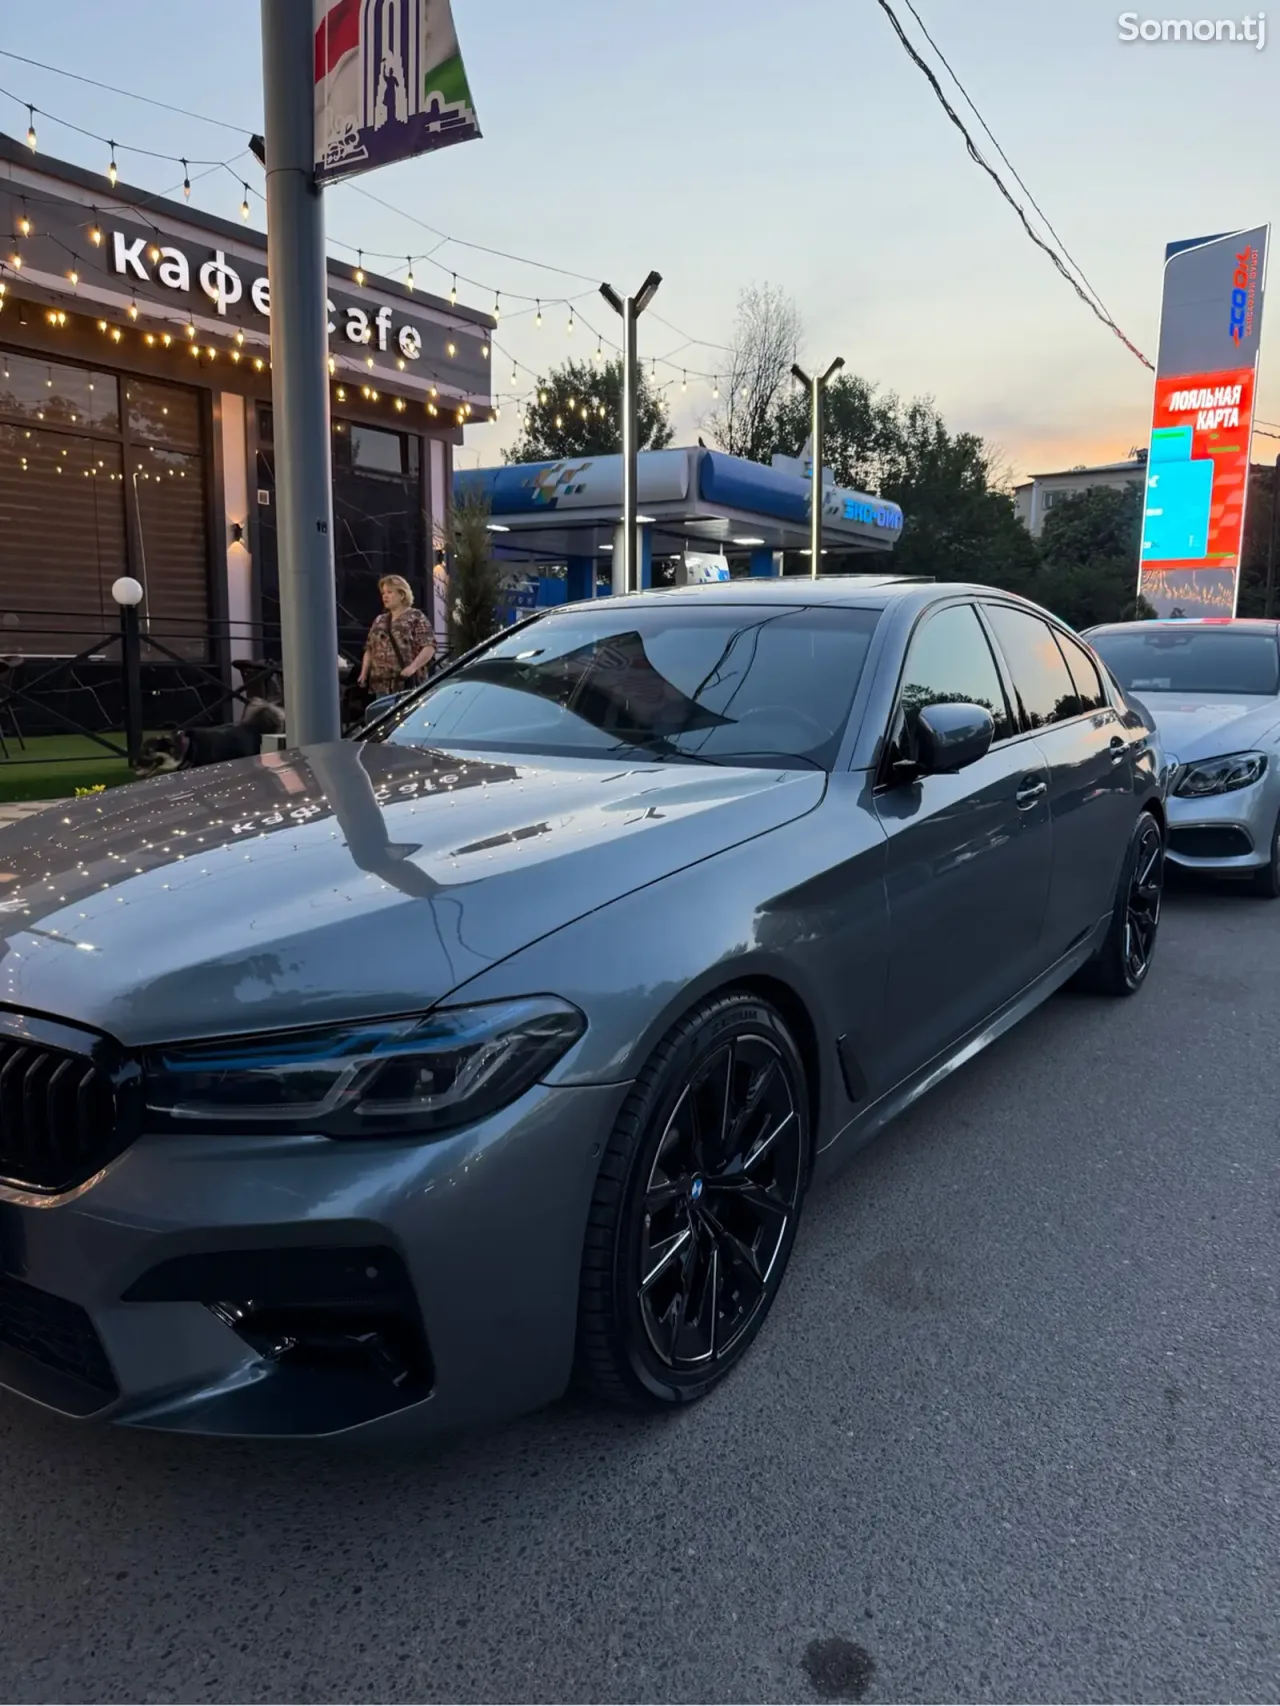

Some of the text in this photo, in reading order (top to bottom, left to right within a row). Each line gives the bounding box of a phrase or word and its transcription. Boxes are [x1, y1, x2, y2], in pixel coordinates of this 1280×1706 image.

[112, 230, 270, 316] кафе
[1168, 384, 1242, 412] ЛОЯЛЬНАЯ
[1196, 407, 1239, 430] КАРТА
